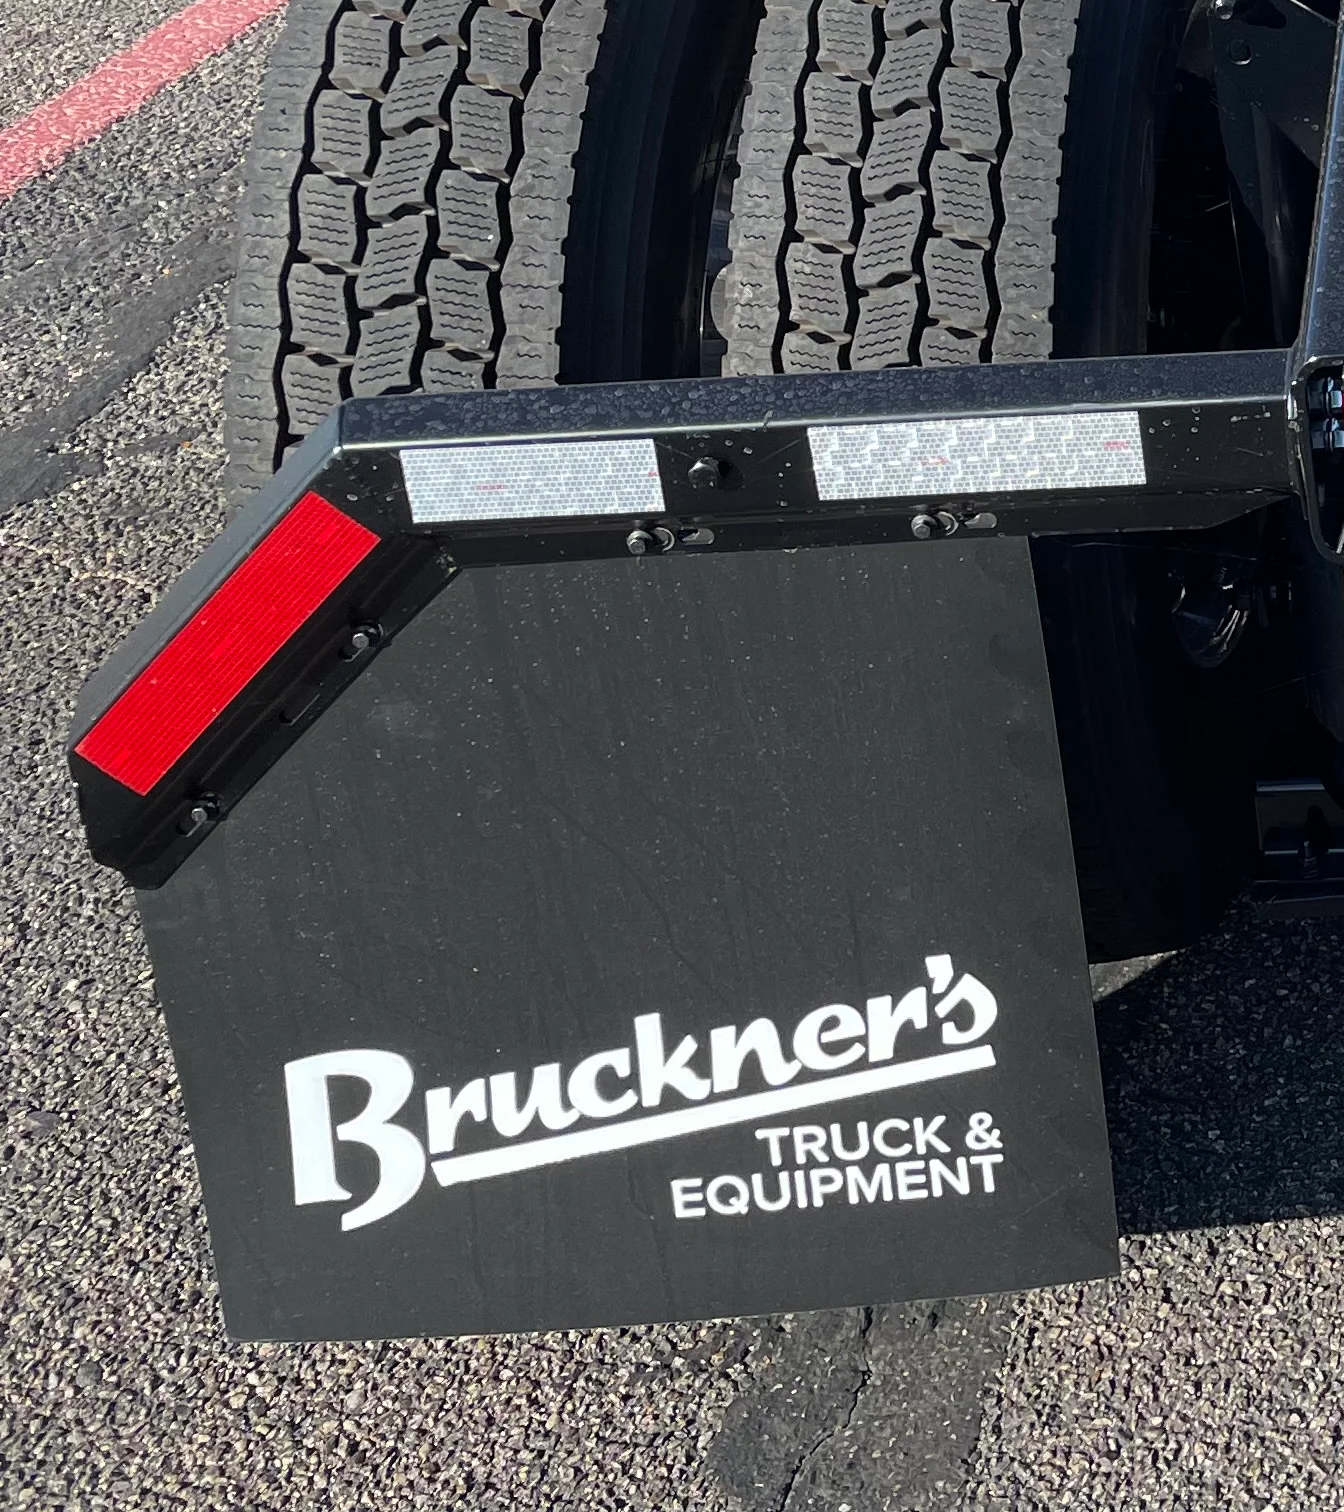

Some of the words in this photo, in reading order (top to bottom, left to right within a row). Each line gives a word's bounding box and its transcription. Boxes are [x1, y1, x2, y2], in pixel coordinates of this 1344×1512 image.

[283, 953, 998, 1232] Bruckner's
[754, 1115, 952, 1167] TRUCK
[964, 1111, 1004, 1151] &
[670, 1153, 1004, 1219] EQUIPMENT
